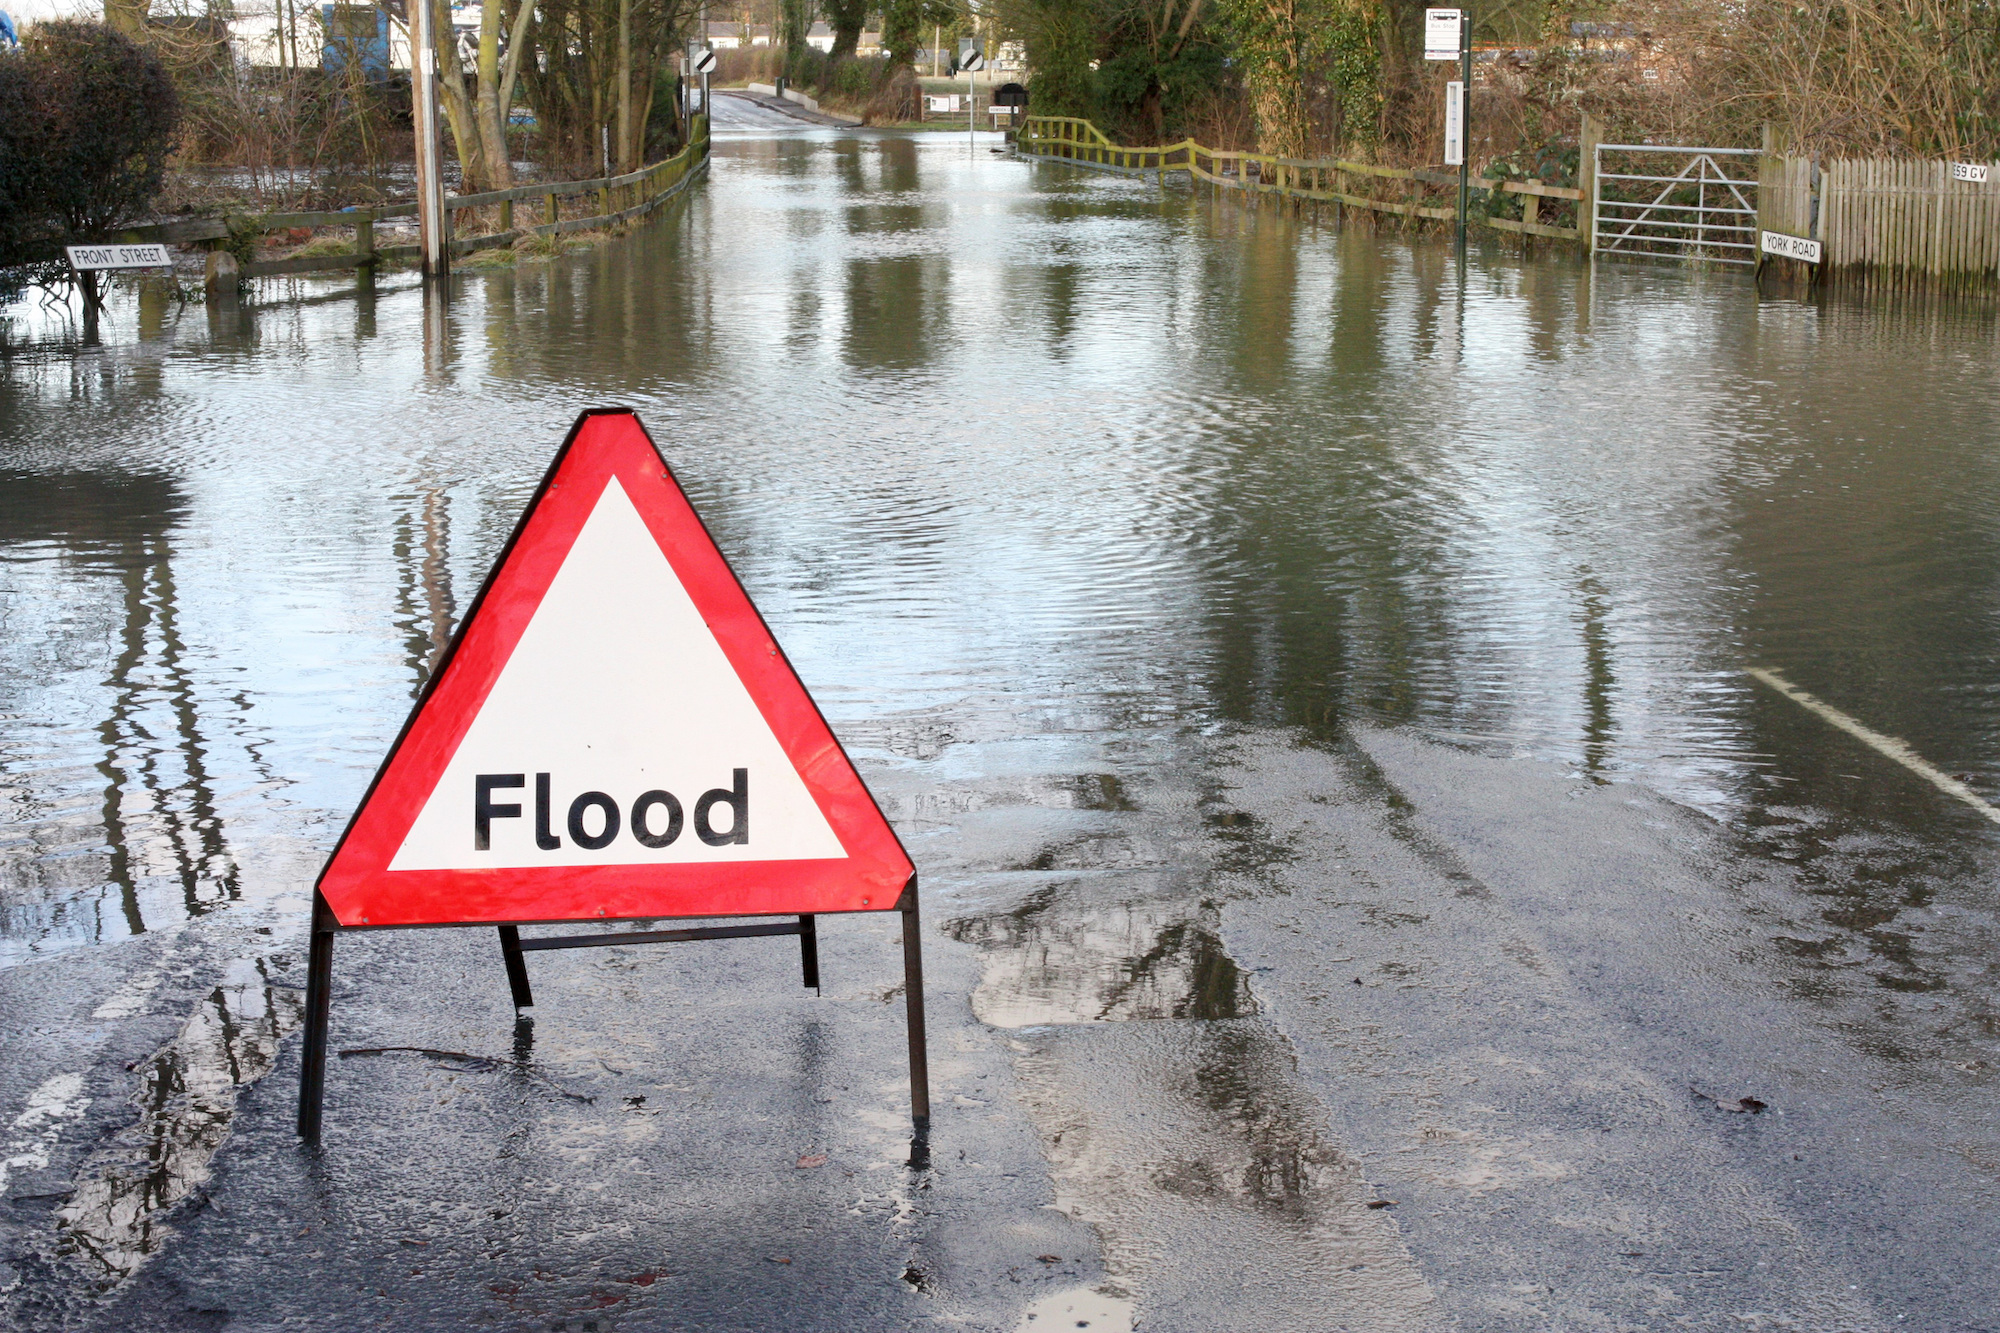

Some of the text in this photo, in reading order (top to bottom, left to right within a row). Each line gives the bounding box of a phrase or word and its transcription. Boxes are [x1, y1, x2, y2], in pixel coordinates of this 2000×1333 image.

[74, 248, 163, 265] FRONT STREET
[1767, 235, 1816, 258] YORK ROAD
[474, 767, 749, 851] Flood
